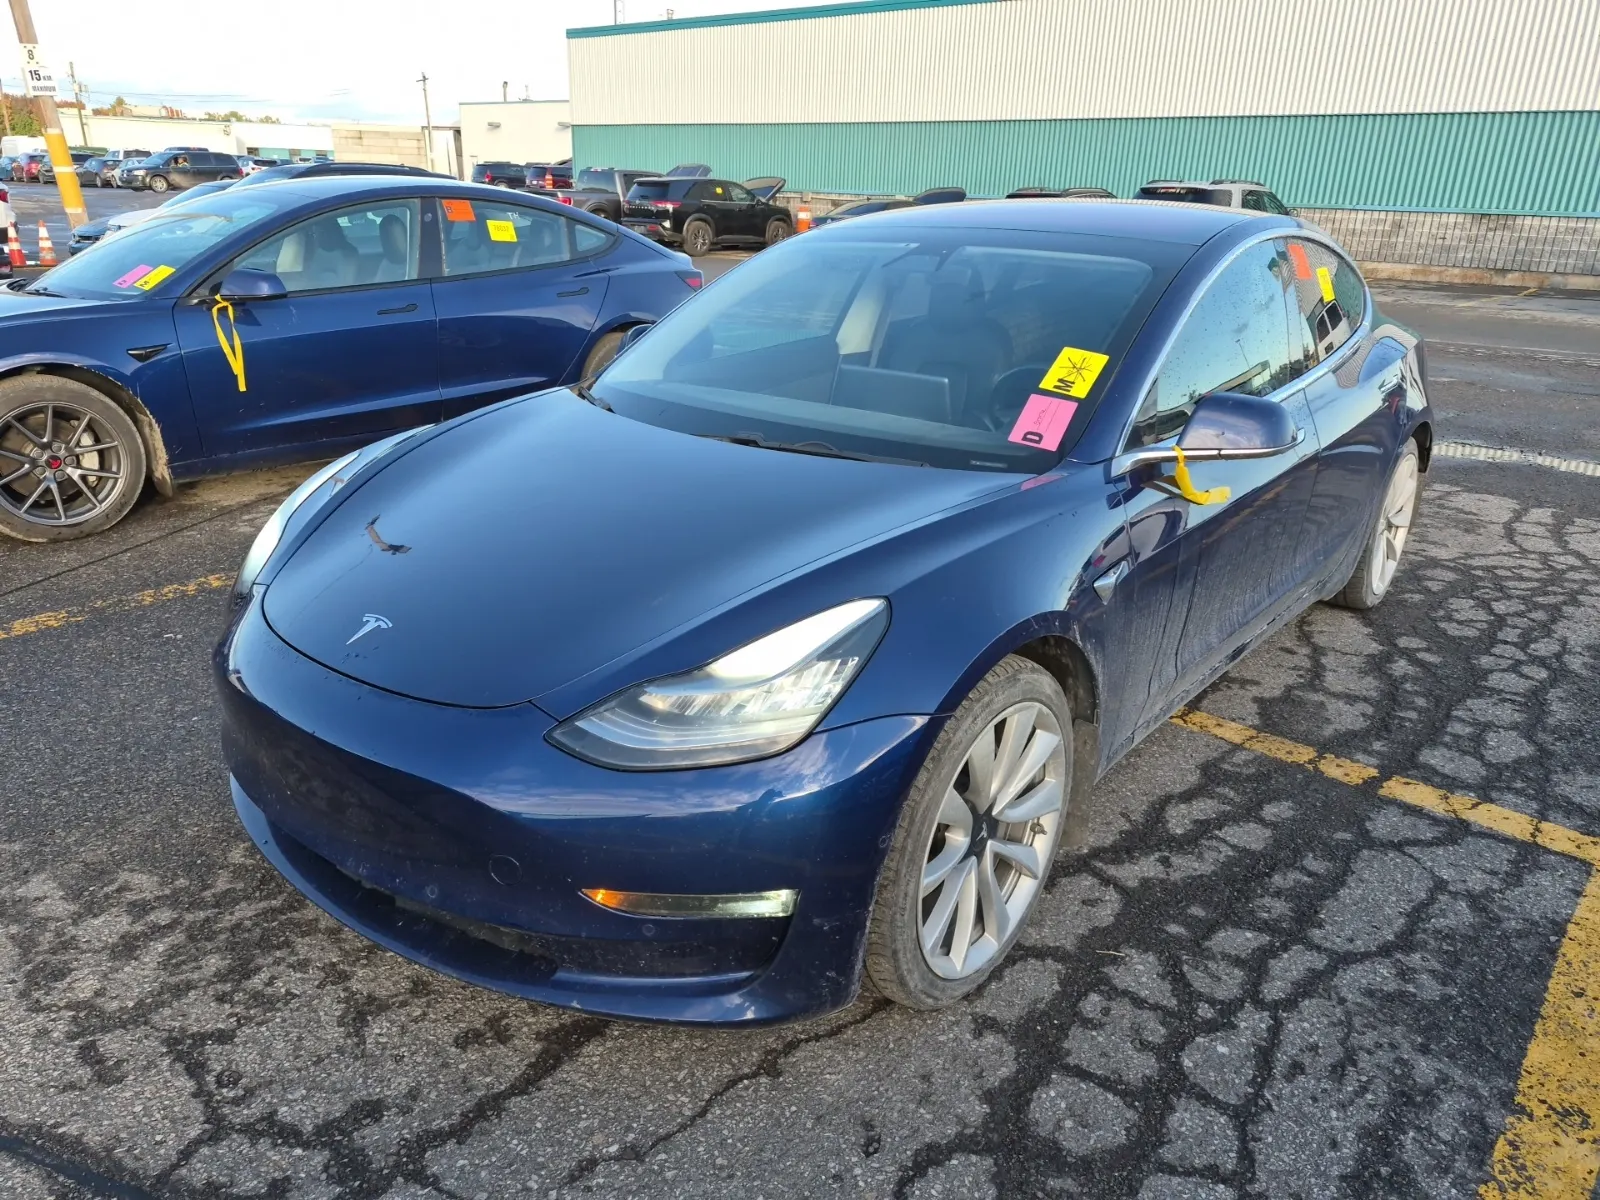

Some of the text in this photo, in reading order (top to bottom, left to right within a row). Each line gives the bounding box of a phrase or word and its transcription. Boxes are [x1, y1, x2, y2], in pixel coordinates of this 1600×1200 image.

[27, 49, 34, 60] 8
[28, 69, 41, 81] 15
[1052, 378, 1076, 393] M
[1021, 430, 1044, 445] D
